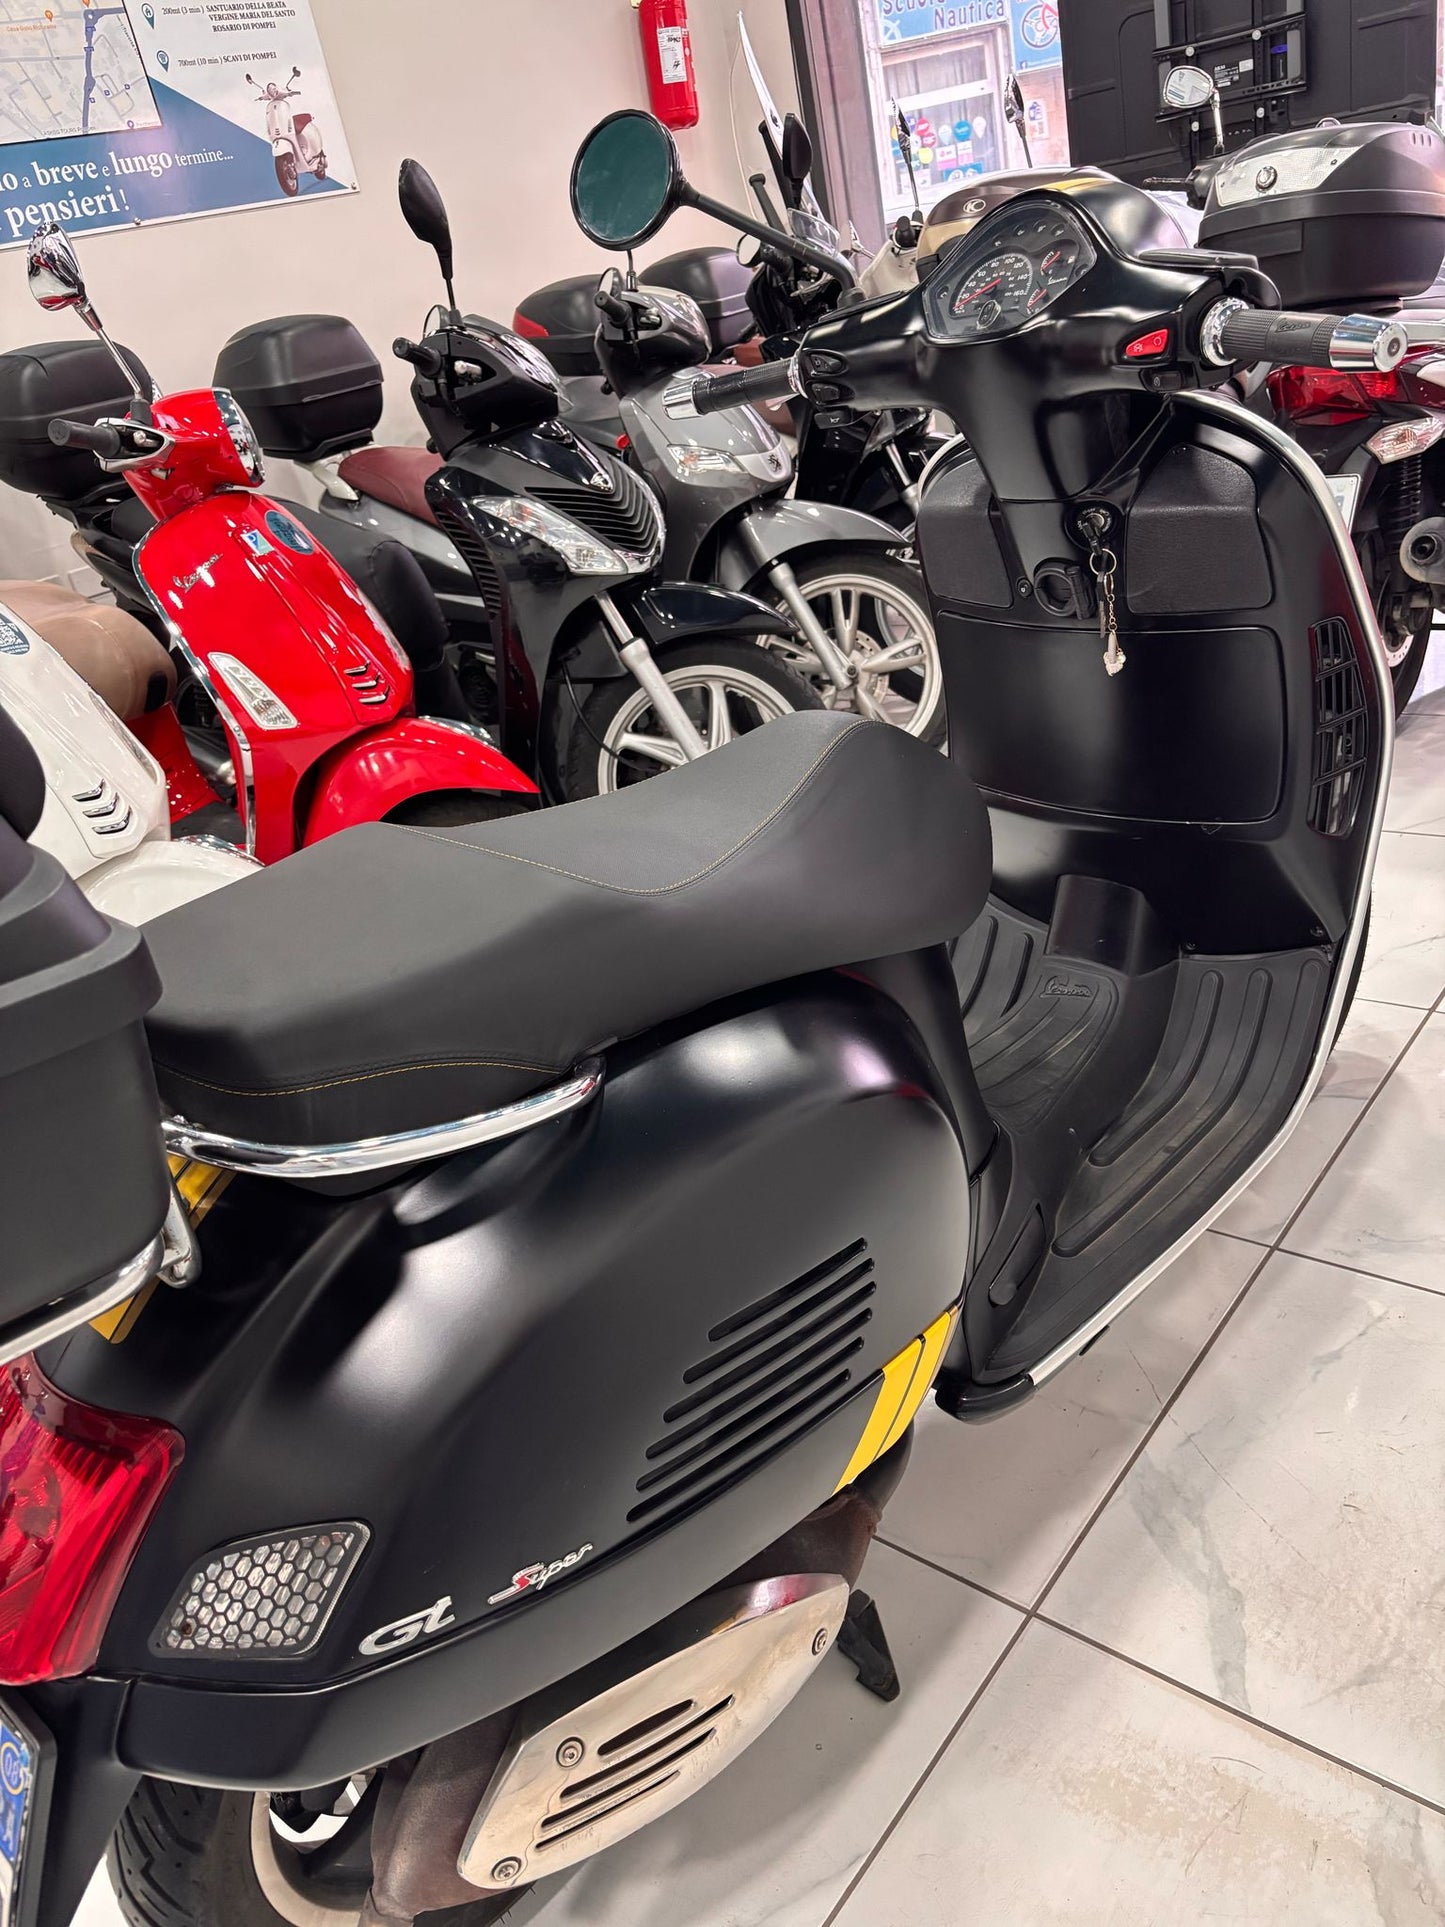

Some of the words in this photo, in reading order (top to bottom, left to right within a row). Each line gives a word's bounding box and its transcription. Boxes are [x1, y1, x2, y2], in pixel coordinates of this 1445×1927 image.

[206, 3, 244, 13] SANTUARIO
[245, 2, 266, 10] DELLA
[266, 1, 286, 9] BEATA
[209, 12, 240, 21] VERGINE
[240, 10, 260, 19] MARIA
[261, 10, 273, 18] DEL
[274, 9, 296, 17] SANTO
[934, 0, 1005, 31] Nautica
[212, 23, 241, 32] ROSARIO
[243, 23, 251, 31] DI
[251, 21, 276, 30] POMPEI
[222, 55, 242, 63] SCAVI
[252, 52, 277, 61] POMPEI
[22, 175, 32, 188] a
[30, 160, 99, 186] breve
[101, 164, 111, 177] e
[108, 150, 172, 178] lungo
[174, 148, 234, 167] termine...
[4, 184, 120, 237] pensieri
